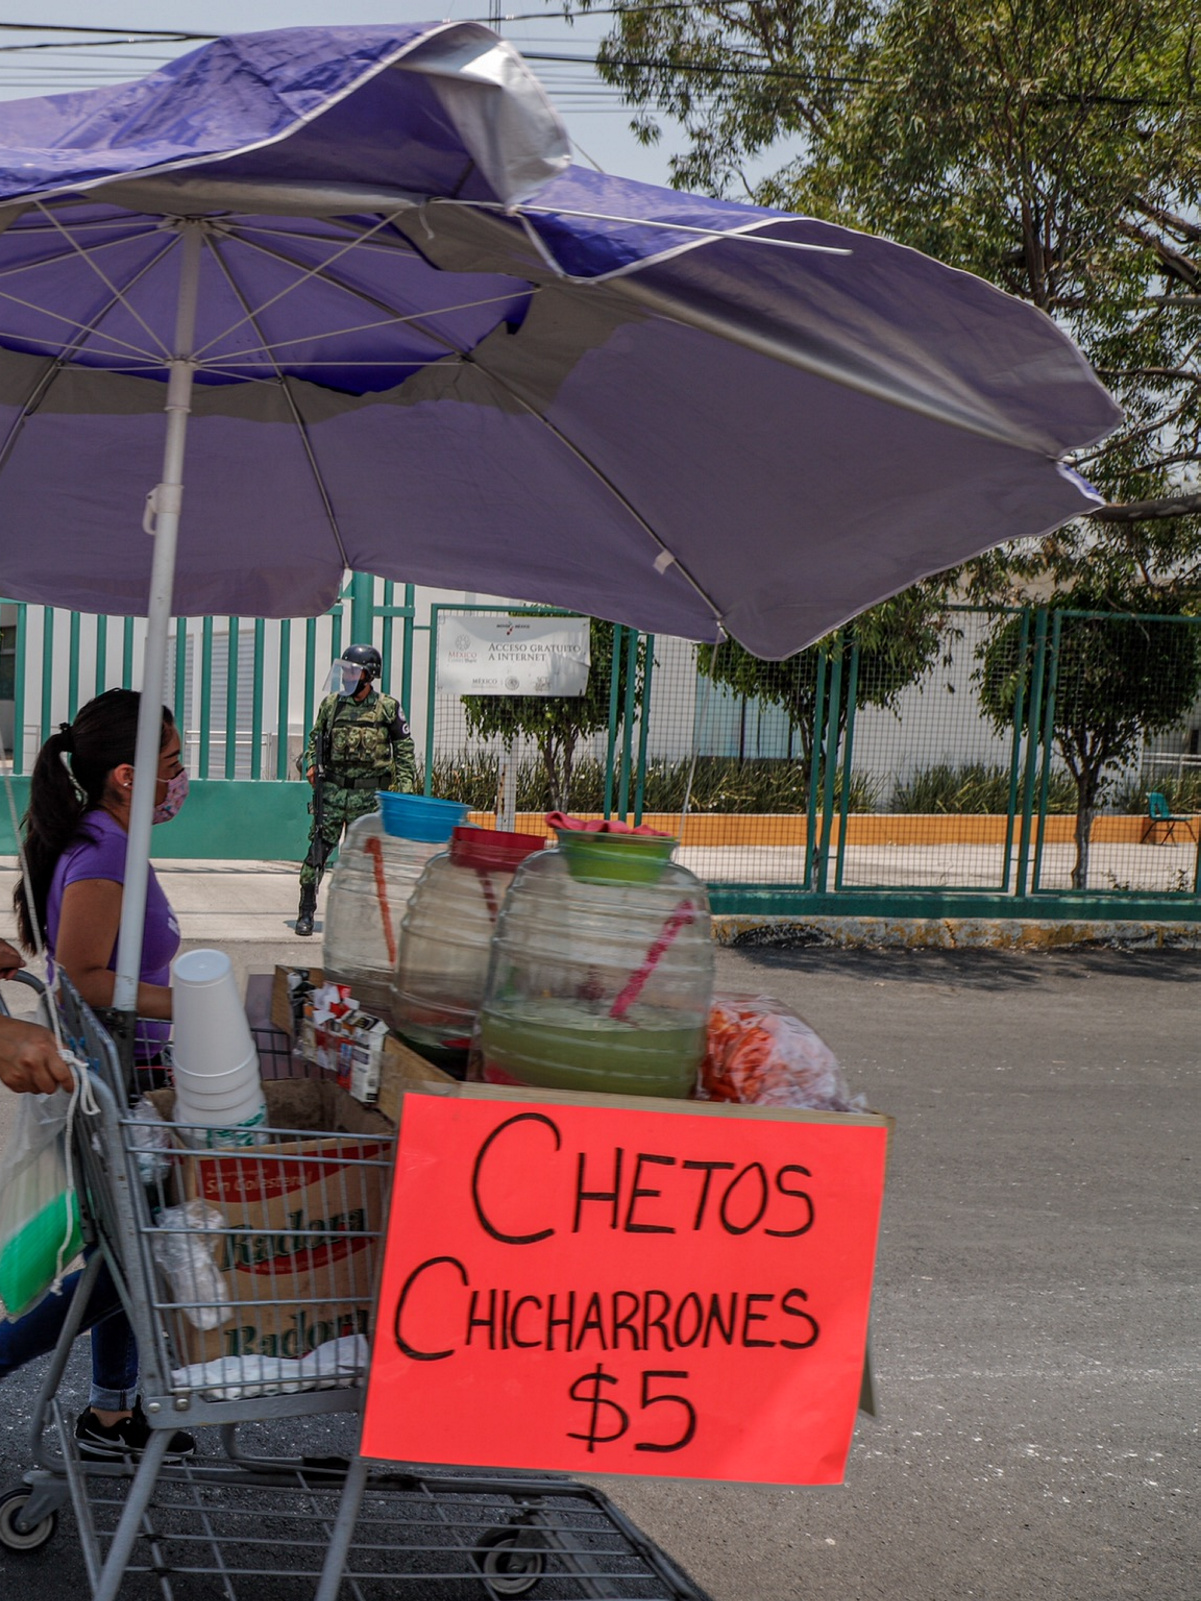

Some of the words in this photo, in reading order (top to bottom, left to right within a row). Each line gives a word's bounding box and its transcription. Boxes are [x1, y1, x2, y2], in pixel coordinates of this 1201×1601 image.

[488, 642, 528, 653] ACCESO
[529, 643, 582, 654] GRATUITO
[488, 652, 496, 662] A
[497, 652, 547, 662] INTERNET
[472, 1112, 815, 1245] CHETOS
[393, 1255, 821, 1361] CHICHARRONES
[566, 1363, 697, 1453] $5
